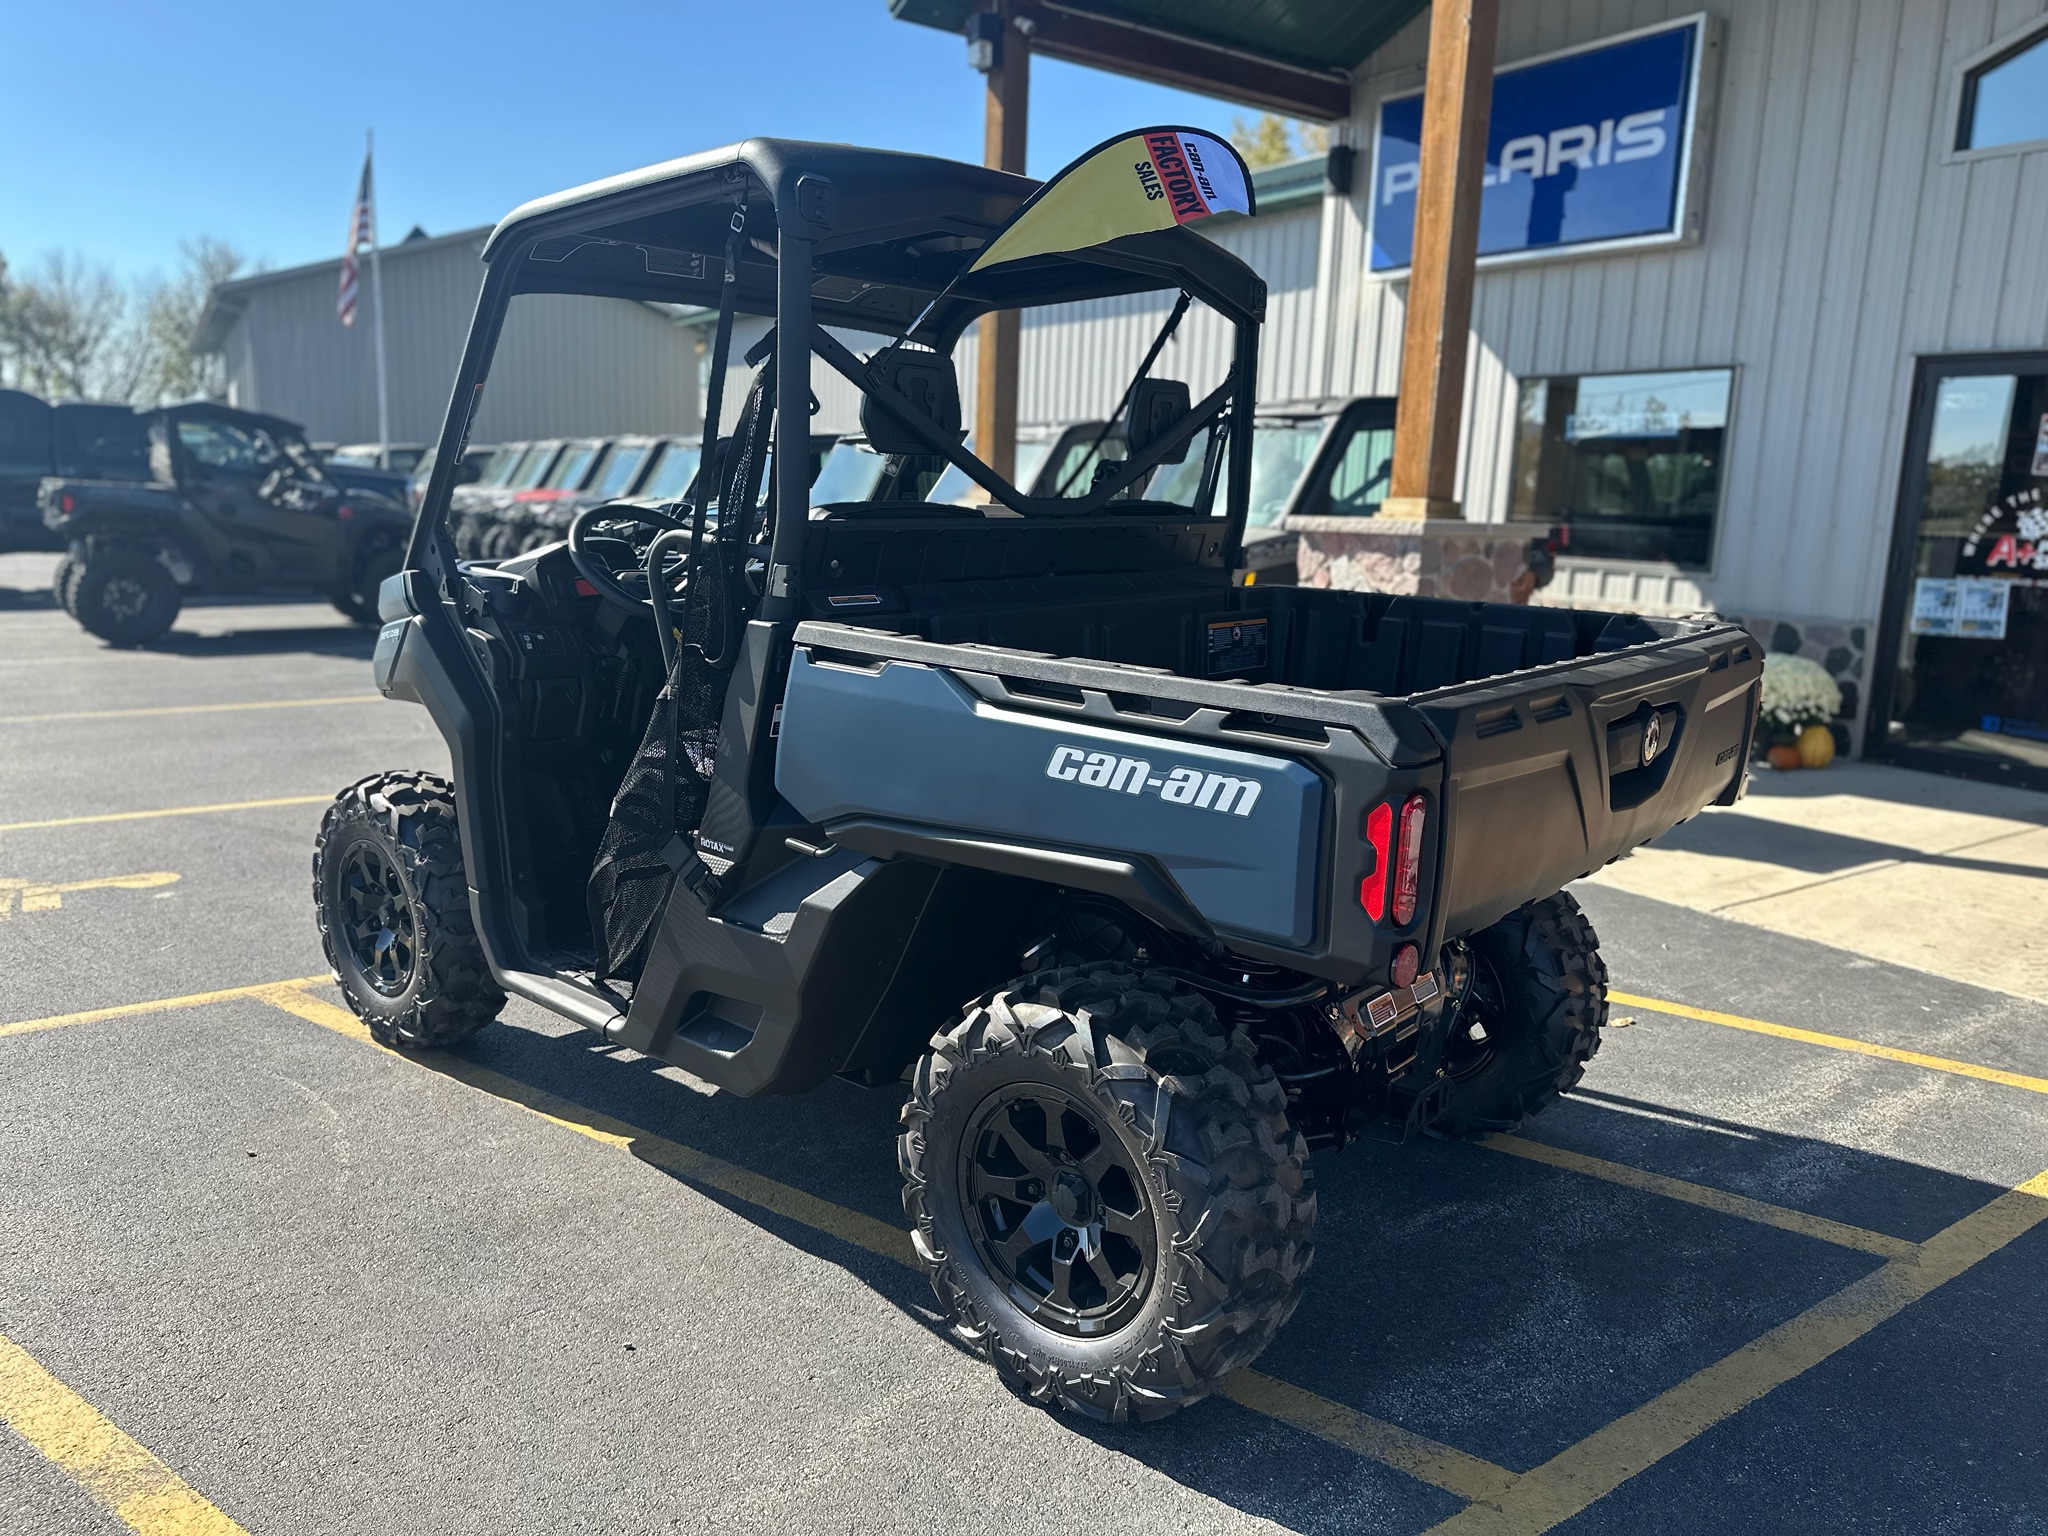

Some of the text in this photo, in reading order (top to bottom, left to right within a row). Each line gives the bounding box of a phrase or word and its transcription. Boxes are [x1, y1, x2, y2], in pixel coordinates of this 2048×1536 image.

[1134, 161, 1165, 201] SALES
[1149, 135, 1205, 216] FACTORY
[1184, 142, 1218, 201] can-am
[1382, 109, 1666, 206] PARIS
[1046, 746, 1262, 817] can-am
[700, 836, 724, 853] ROTAX
[1112, 1316, 1156, 1360] FORCE
